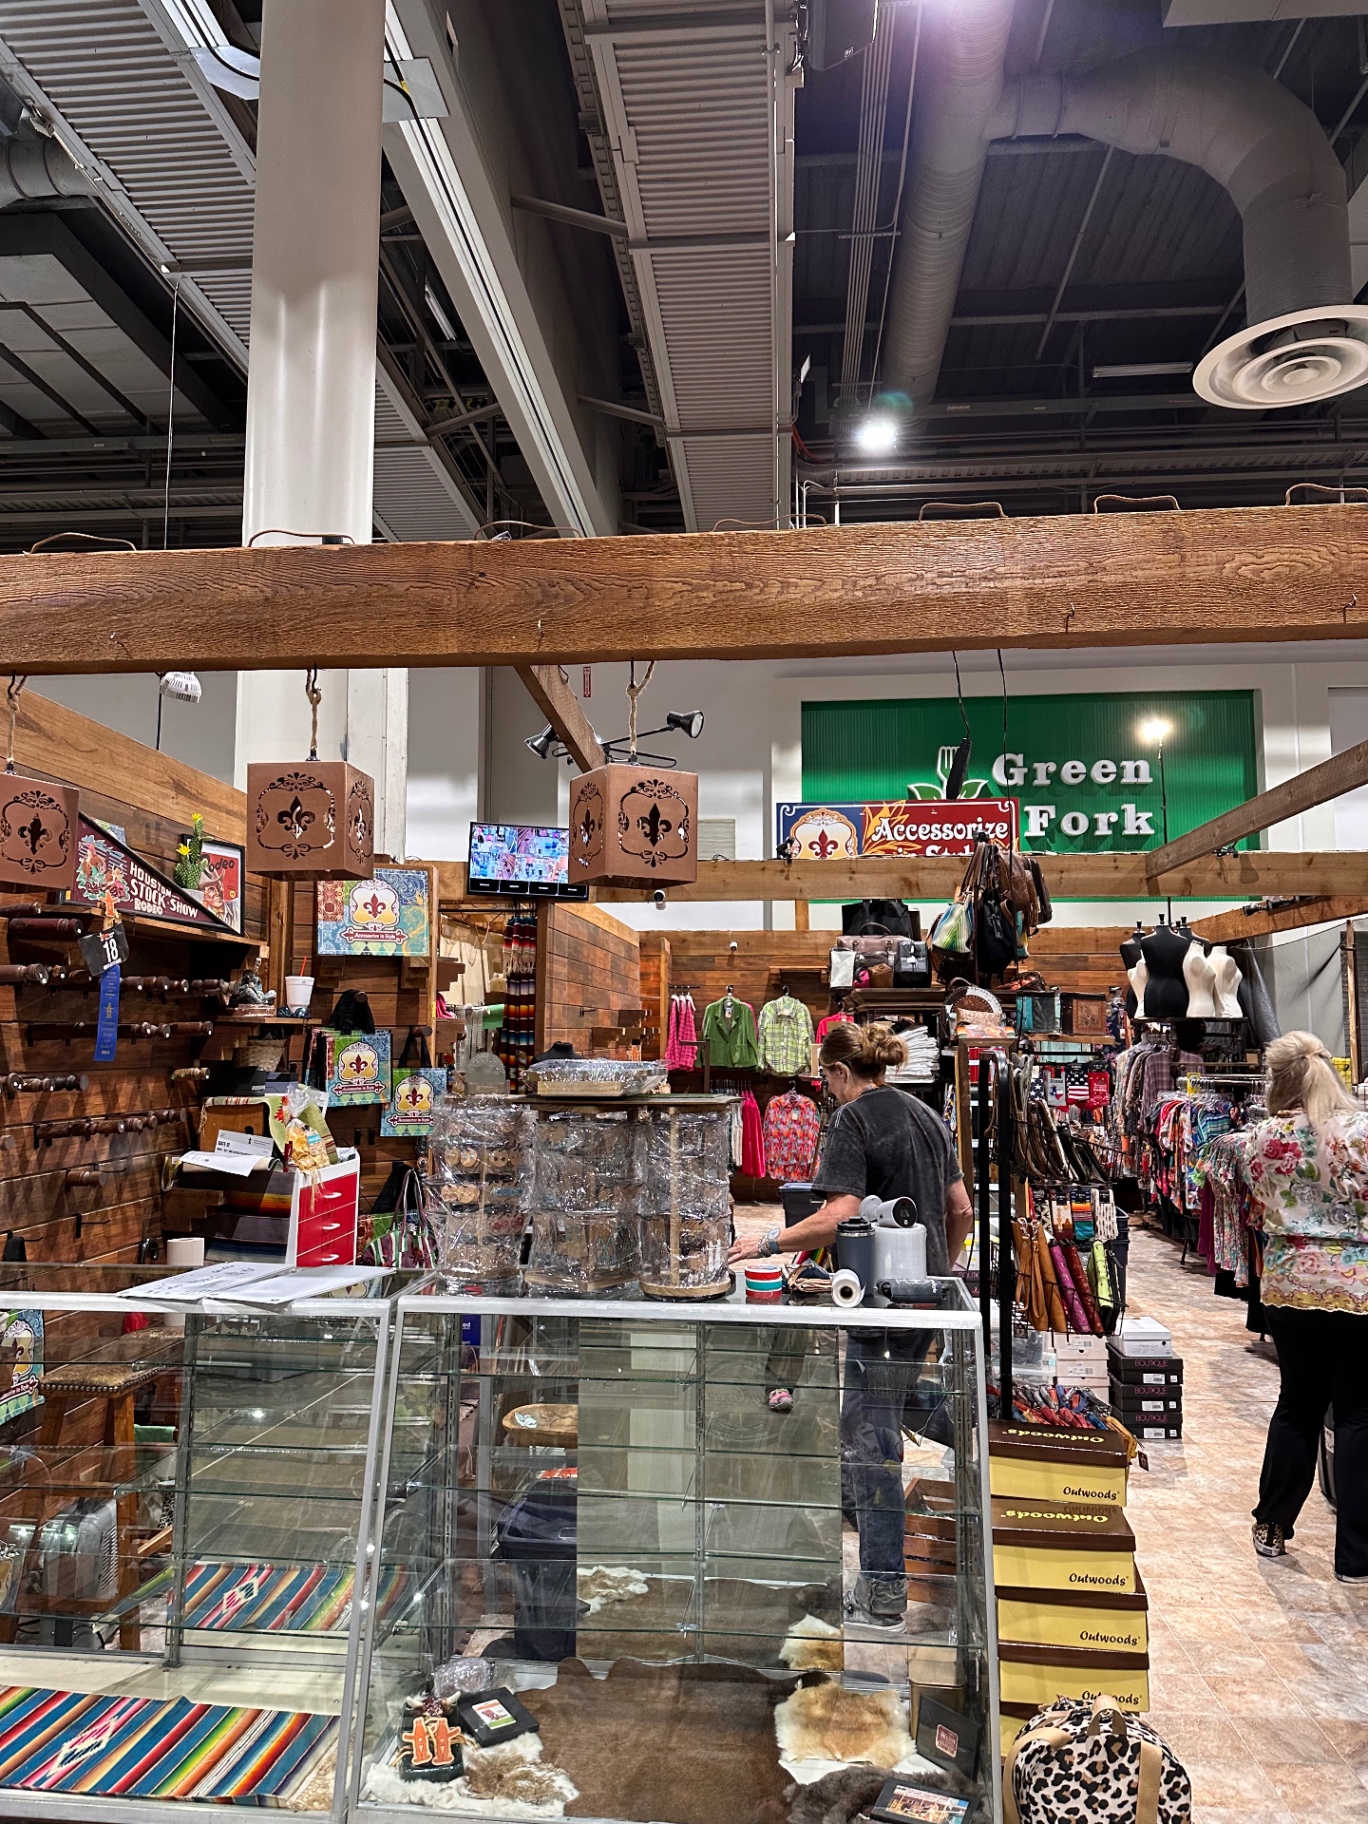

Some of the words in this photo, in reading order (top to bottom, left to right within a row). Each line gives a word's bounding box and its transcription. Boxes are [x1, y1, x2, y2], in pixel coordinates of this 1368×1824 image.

[992, 753, 1153, 787] Green
[871, 815, 1009, 842] Accessorize
[1024, 803, 1155, 837] Fork
[130, 861, 172, 897] HOUSTON
[130, 878, 167, 909] STOCK
[169, 898, 199, 919] SHOW
[134, 897, 164, 916] RODEO
[102, 938, 119, 963] 18
[1007, 1428, 1105, 1443] Outwoods
[1063, 1486, 1117, 1501] Outwoods
[1005, 1509, 1109, 1523] Outwoods
[1069, 1572, 1126, 1587] Outwoods
[1079, 1630, 1138, 1646] Outwoods
[1081, 1690, 1139, 1706] Ouods
